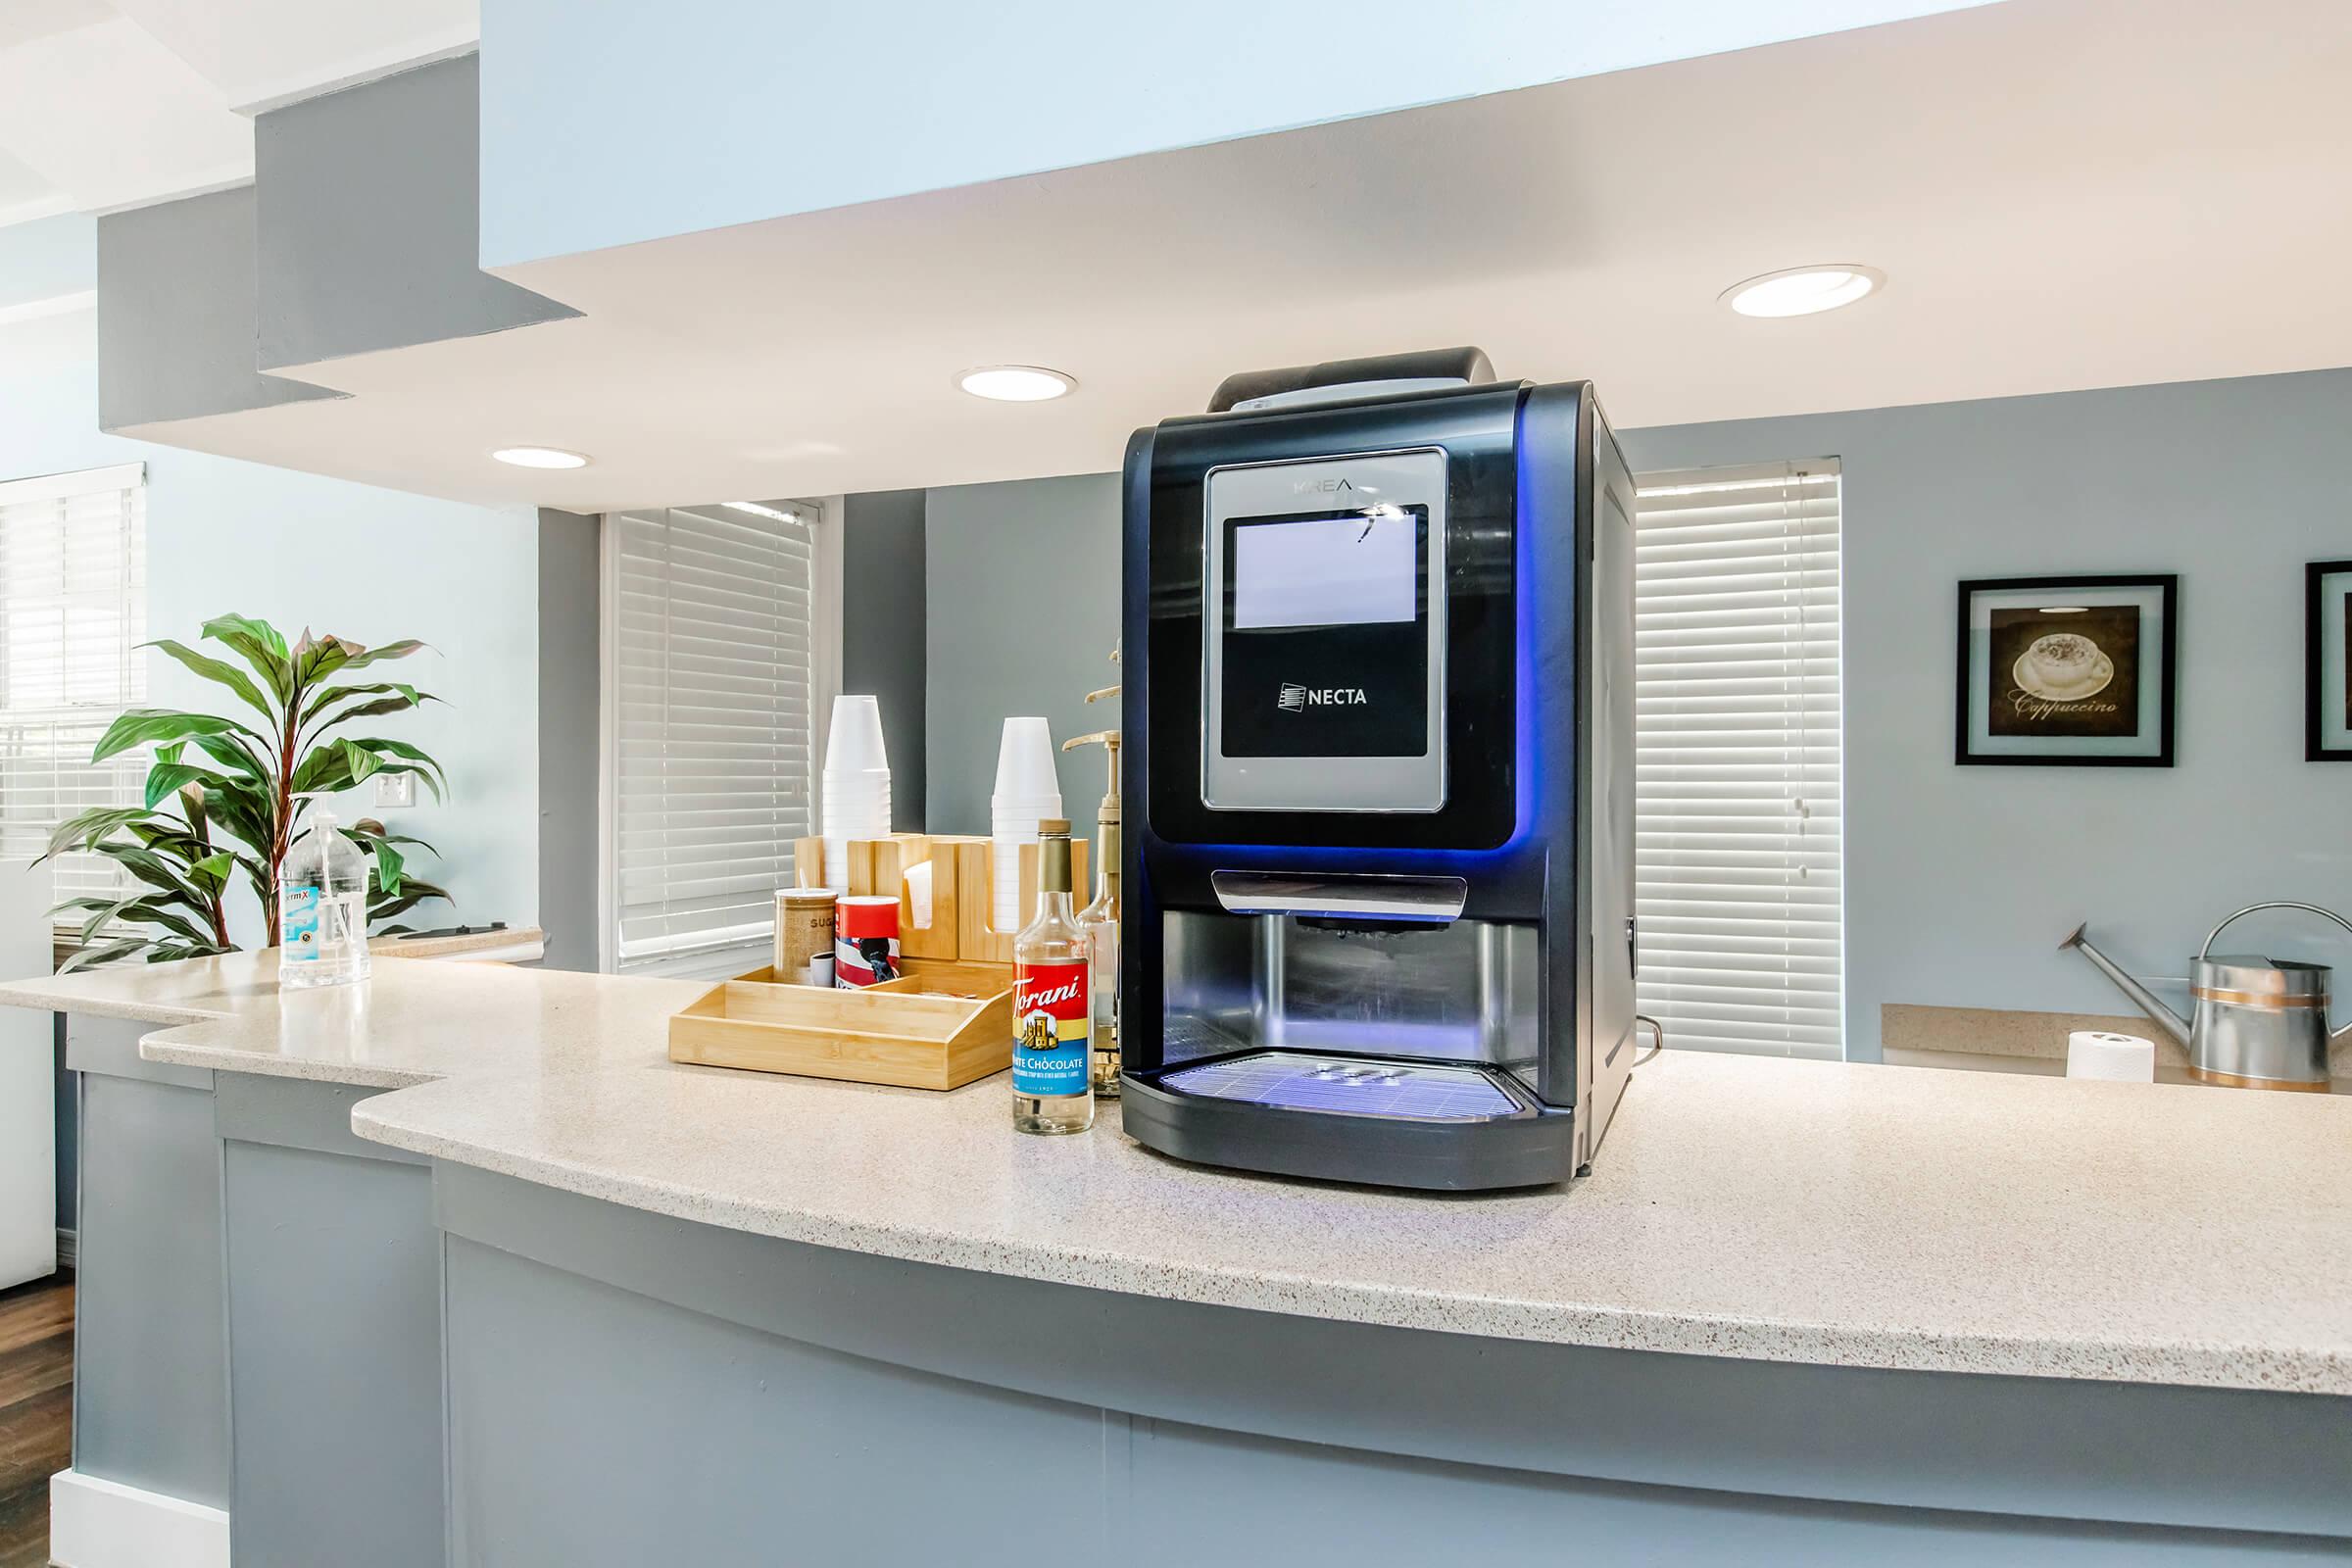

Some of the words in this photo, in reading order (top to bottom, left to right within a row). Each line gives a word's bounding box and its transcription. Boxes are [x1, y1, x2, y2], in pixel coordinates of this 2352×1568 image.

[1308, 688, 1367, 705] NECTA
[2007, 688, 2117, 720] Cappuccino
[809, 917, 833, 928] SUG
[1012, 975, 1079, 1019] Torani
